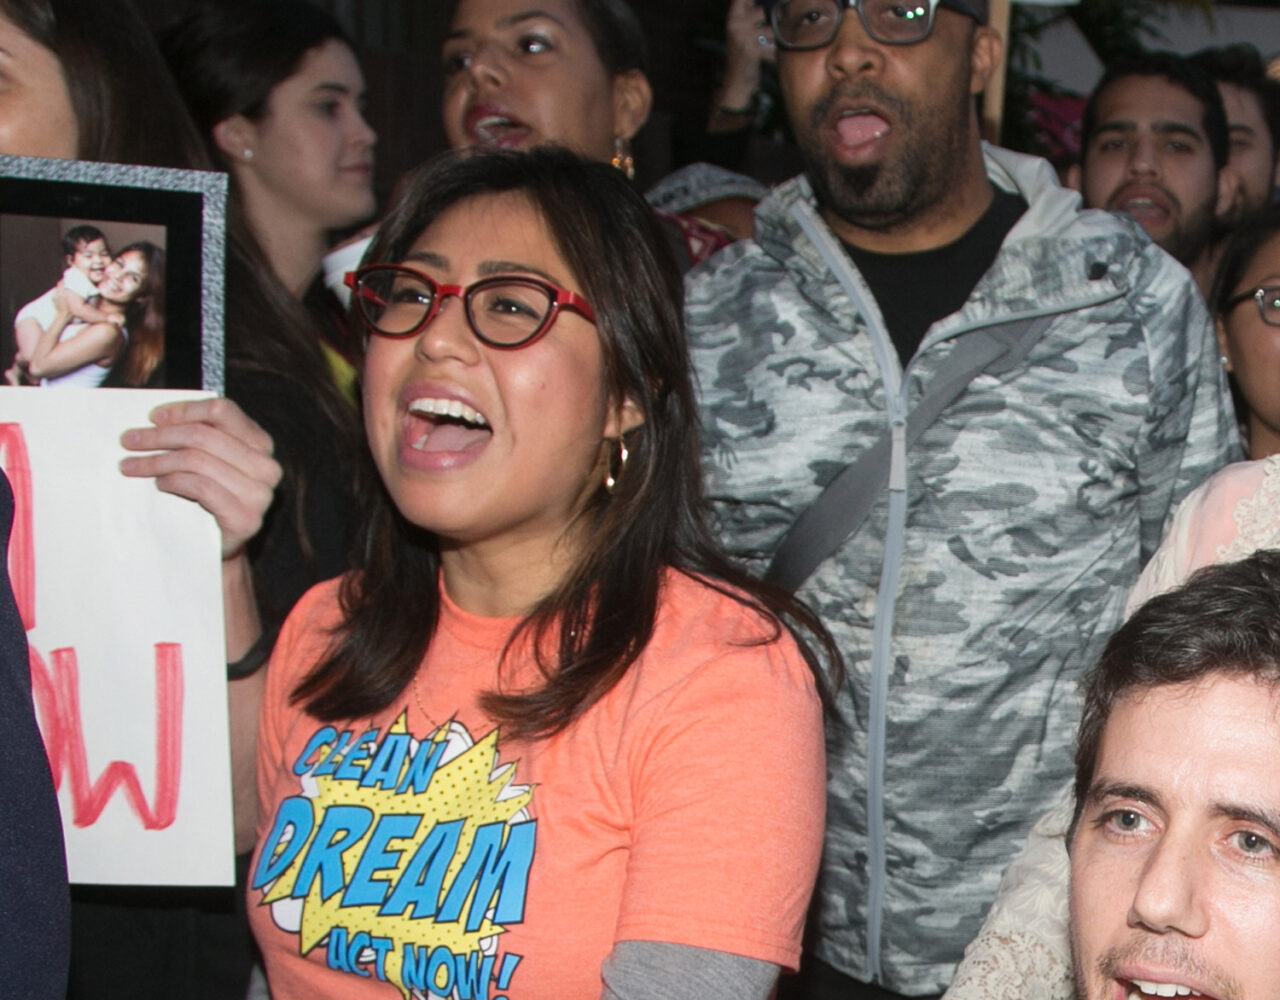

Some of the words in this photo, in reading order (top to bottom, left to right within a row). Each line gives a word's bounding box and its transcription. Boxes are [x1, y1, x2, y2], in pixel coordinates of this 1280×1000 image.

[293, 725, 450, 795] CLEAN
[252, 796, 537, 933] DREAM
[326, 925, 394, 981] ACT
